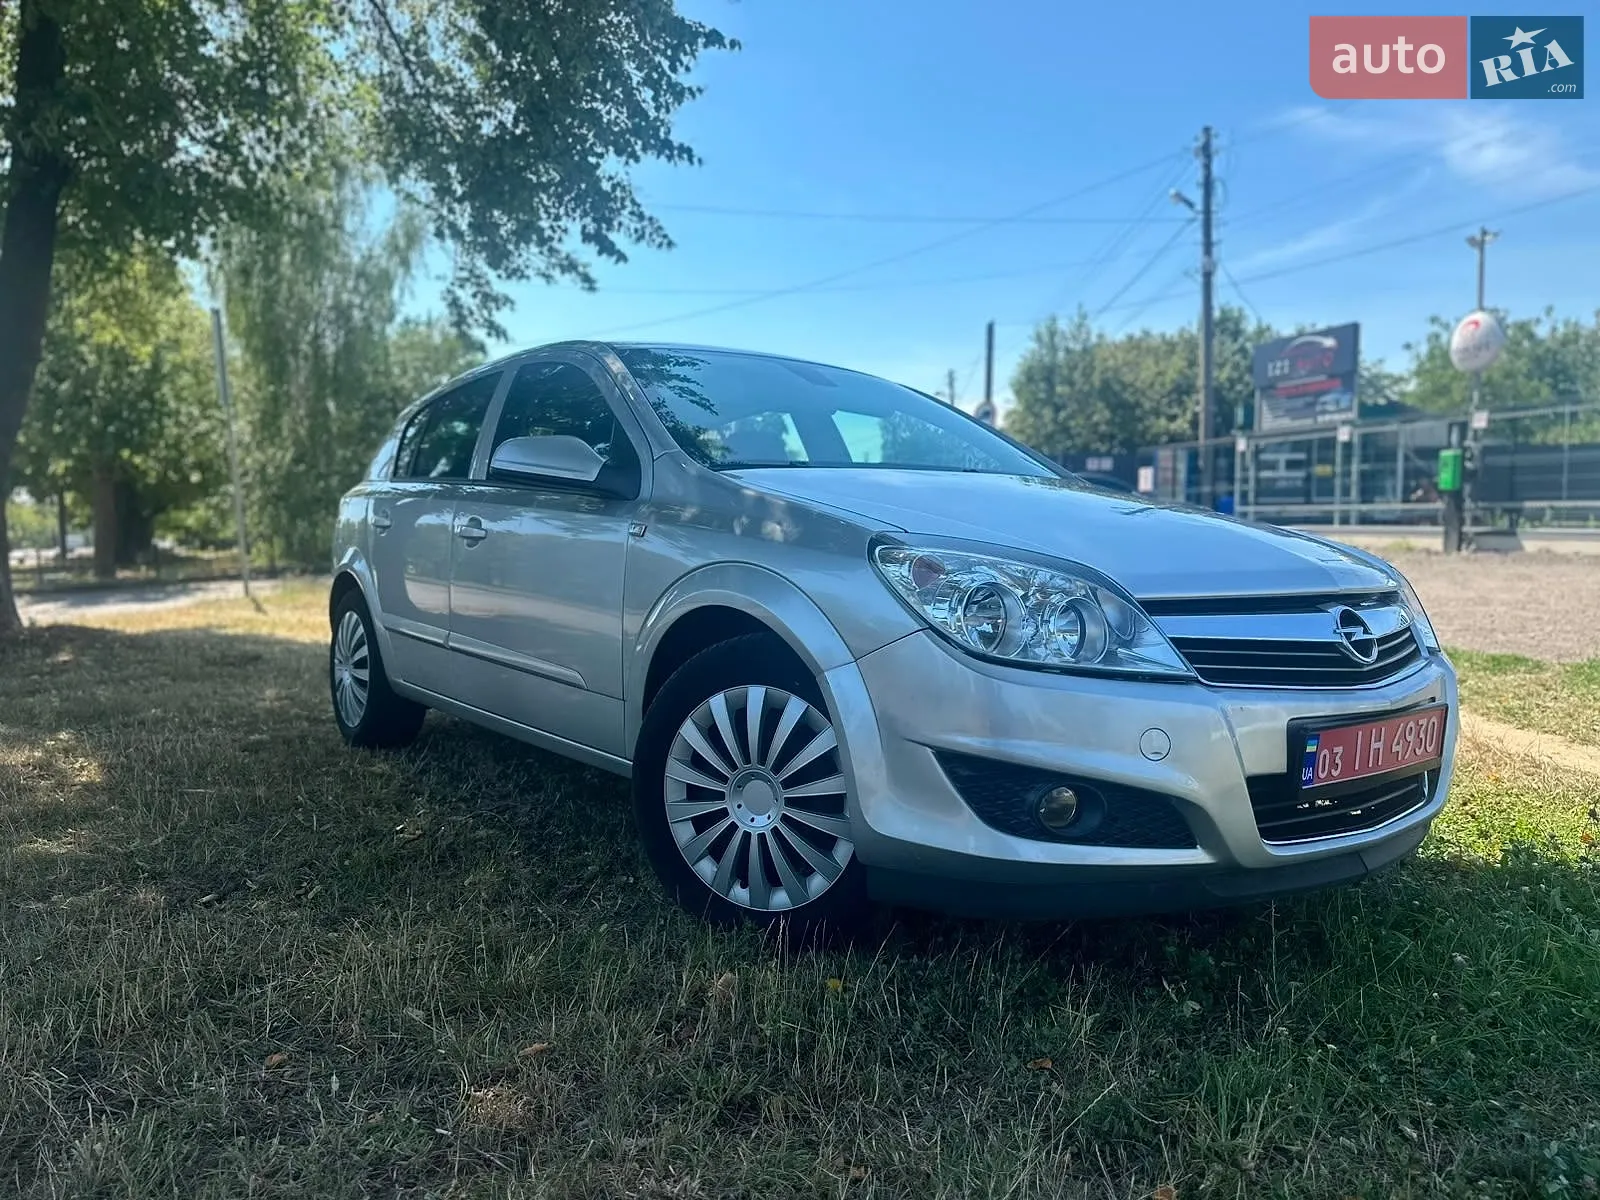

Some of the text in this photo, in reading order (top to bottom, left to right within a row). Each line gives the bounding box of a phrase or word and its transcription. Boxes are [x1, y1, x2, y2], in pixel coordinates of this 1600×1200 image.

[1317, 715, 1438, 779] 03 IH 4930
[1301, 766, 1313, 781] UA
